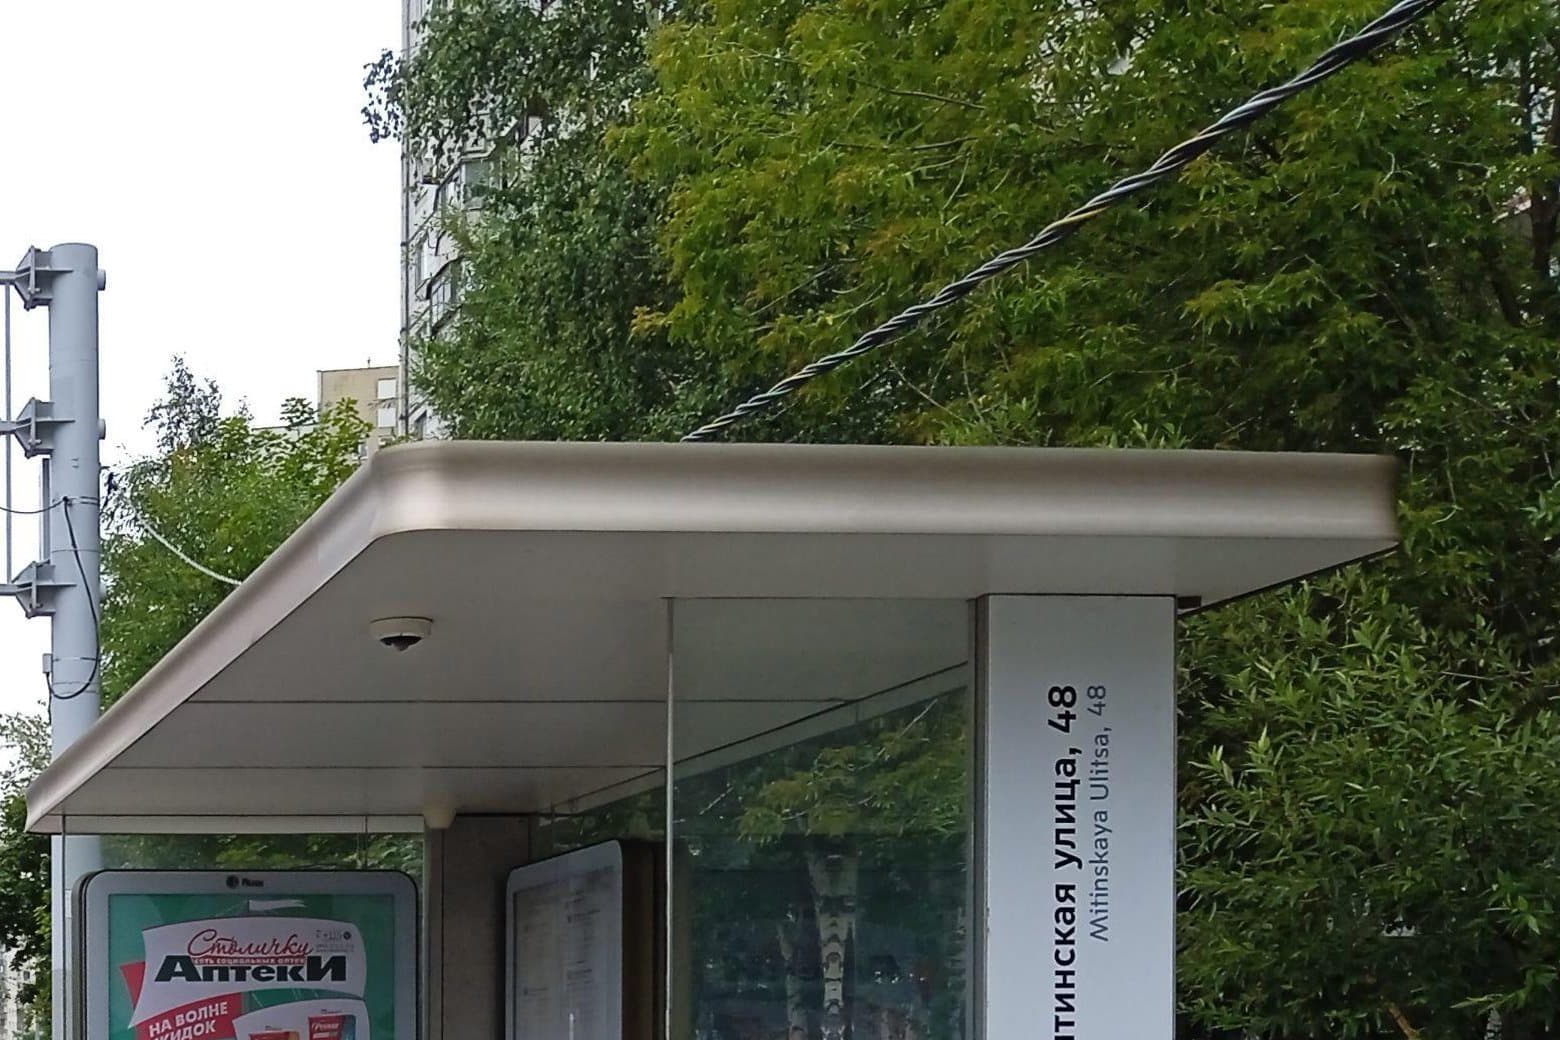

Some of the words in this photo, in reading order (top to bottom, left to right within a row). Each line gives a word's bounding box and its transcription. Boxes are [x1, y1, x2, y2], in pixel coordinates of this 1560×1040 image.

[1046, 685, 1078, 734] 48
[1086, 685, 1107, 717] 48
[1088, 726, 1113, 801] Ulitsa,
[1053, 747, 1083, 870] улица,
[1088, 809, 1113, 942] Mitinskaya
[187, 928, 314, 957] Столички
[148, 1018, 173, 1038] НА
[174, 1001, 228, 1027] ВОЛНЕ
